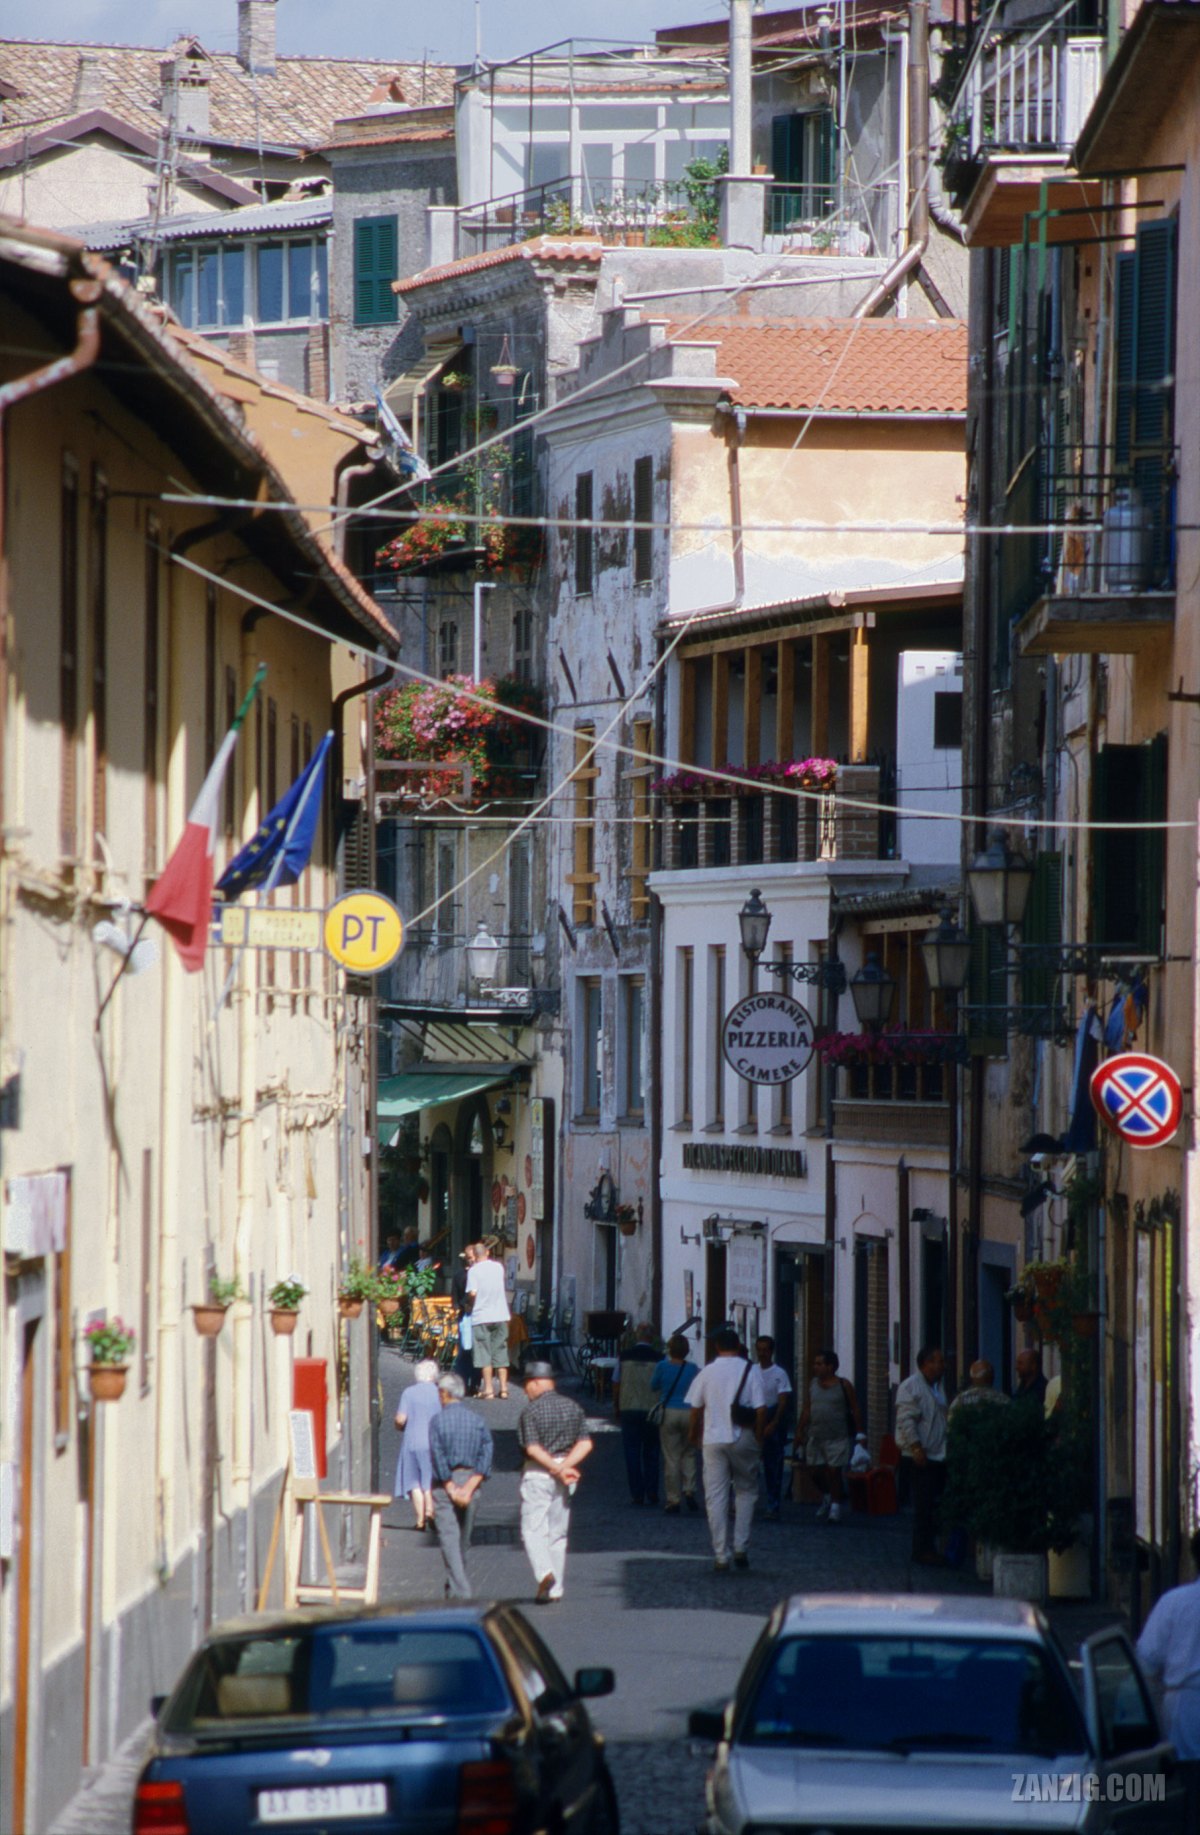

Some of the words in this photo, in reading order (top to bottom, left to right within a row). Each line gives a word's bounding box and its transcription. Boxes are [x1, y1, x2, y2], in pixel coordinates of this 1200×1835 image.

[341, 914, 386, 952] PT
[731, 997, 807, 1030] RISTORANTE
[728, 1031, 810, 1048] PIZZERIA
[737, 1058, 801, 1081] CAMERE
